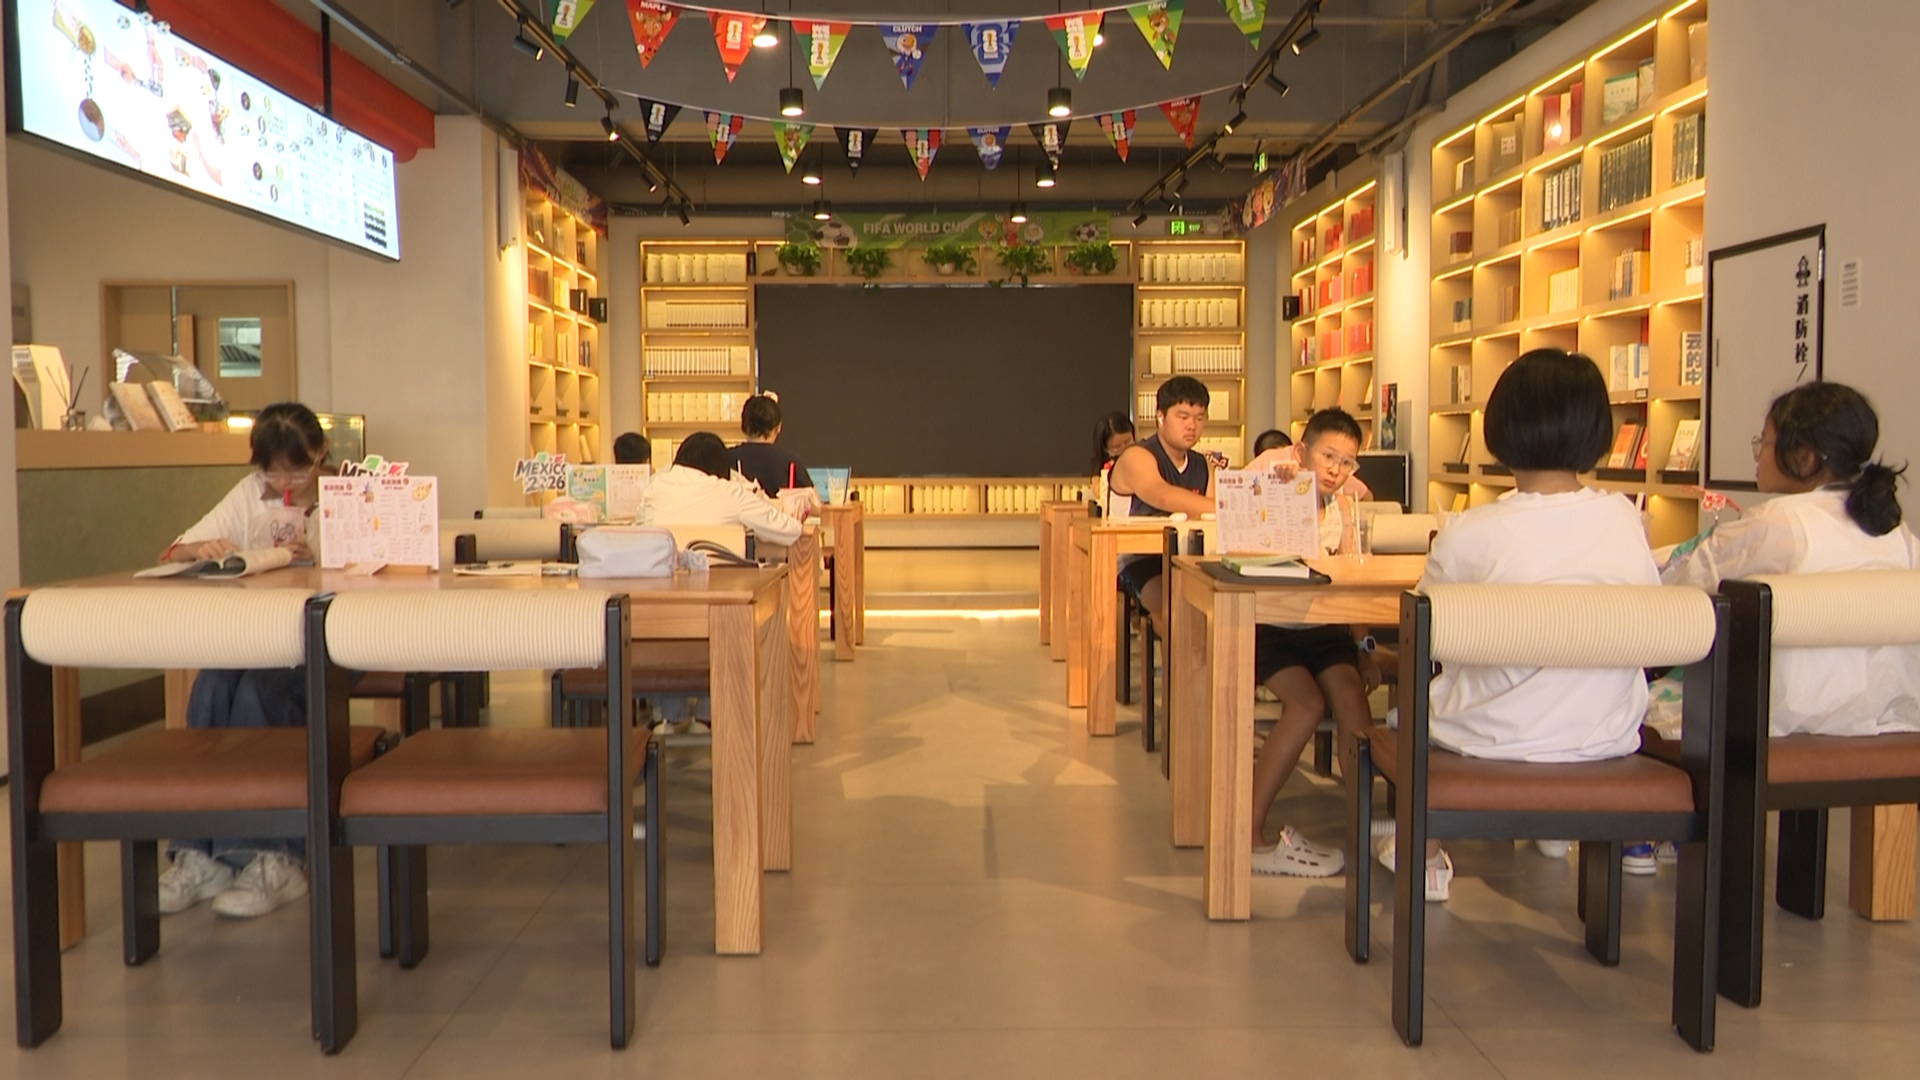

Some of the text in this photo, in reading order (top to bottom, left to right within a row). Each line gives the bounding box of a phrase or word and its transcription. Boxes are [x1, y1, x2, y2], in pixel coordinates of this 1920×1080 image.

[640, 1, 667, 12] MAPLE
[892, 25, 923, 33] CLUTCH
[863, 221, 970, 234] FIFA WORLD CUP
